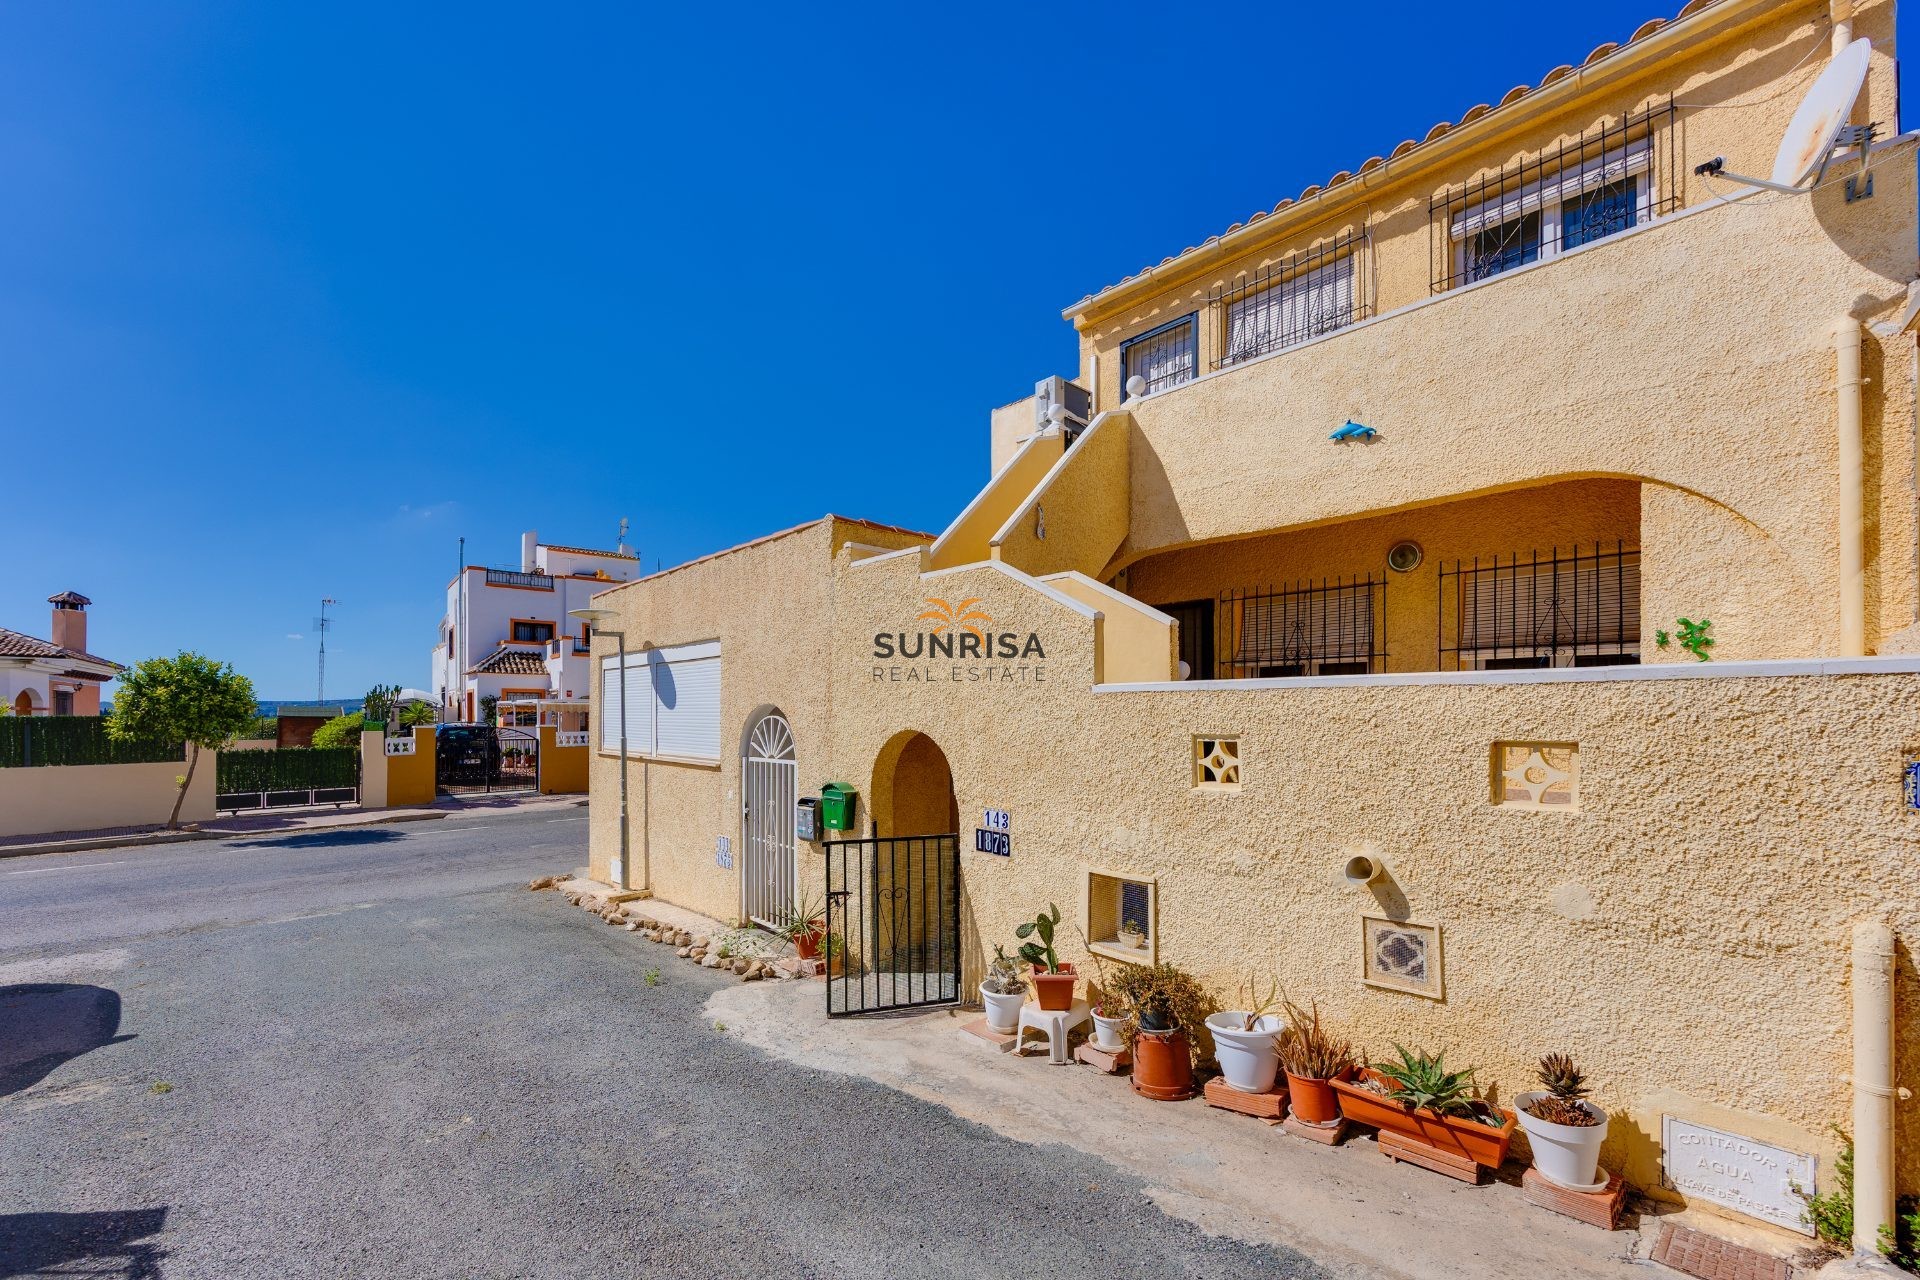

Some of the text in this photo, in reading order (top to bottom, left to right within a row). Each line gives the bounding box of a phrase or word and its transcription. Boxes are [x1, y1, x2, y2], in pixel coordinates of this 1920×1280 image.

[985, 811, 1009, 829] 143
[977, 830, 1009, 854] 1873
[1678, 1133, 1778, 1171] CONTADOR
[1697, 1156, 1754, 1184] AGUA
